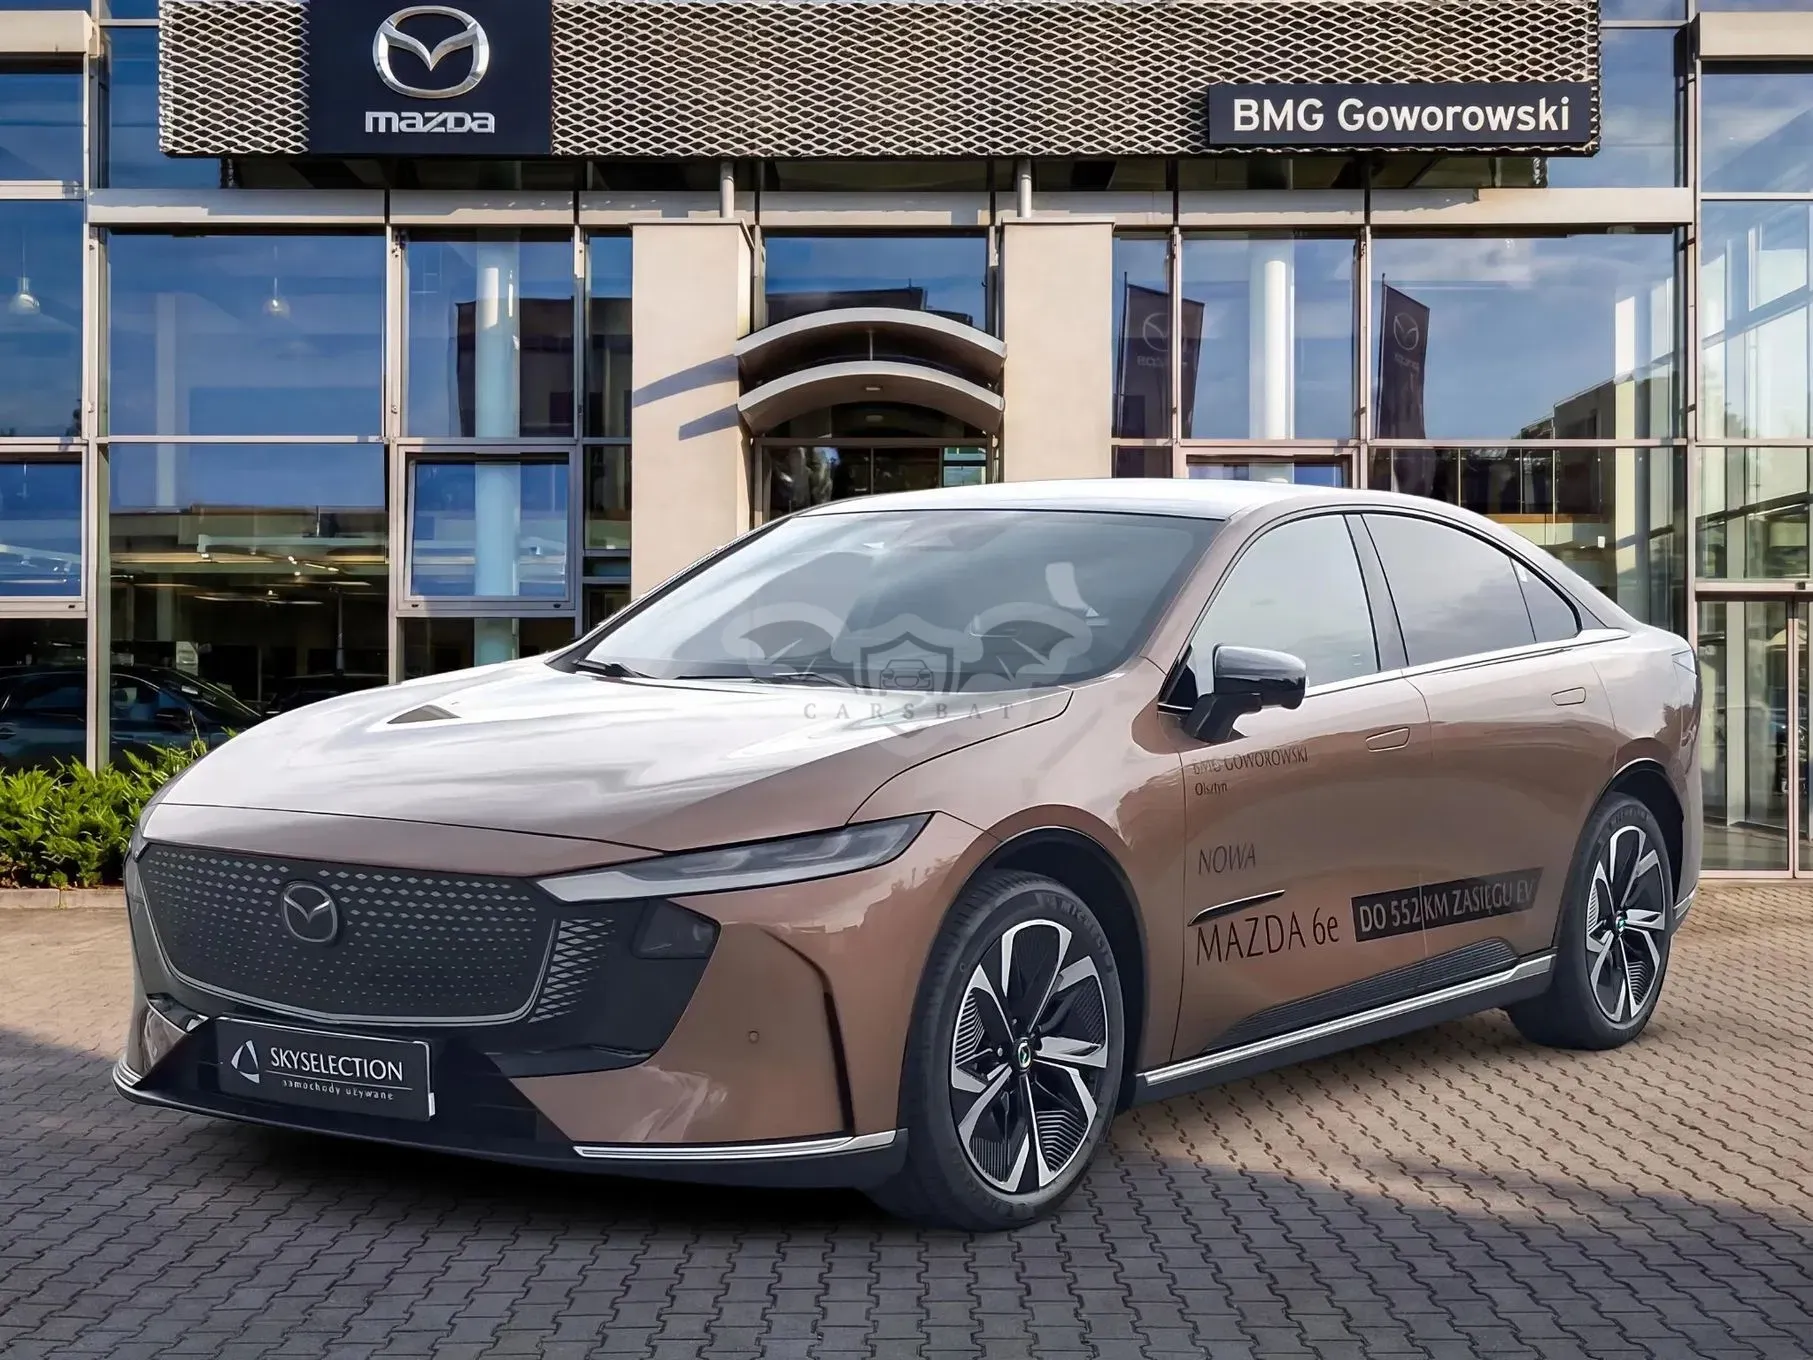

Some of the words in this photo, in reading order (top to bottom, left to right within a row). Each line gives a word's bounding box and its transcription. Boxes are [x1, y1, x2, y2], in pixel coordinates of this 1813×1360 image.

[364, 111, 496, 134] mazda
[1233, 98, 1324, 132] BMG
[1337, 96, 1570, 132] Goworowski
[1223, 746, 1309, 771] GOWOROWSKI
[1198, 843, 1257, 875] NOWA
[1359, 903, 1387, 933] DO
[1390, 897, 1421, 927] 552
[1423, 892, 1449, 921] KM
[1452, 881, 1513, 916] ZASIĘGU
[1196, 911, 1306, 966] MAZDA
[1312, 907, 1340, 946] 6e
[269, 1047, 404, 1082] SKYSELECTION
